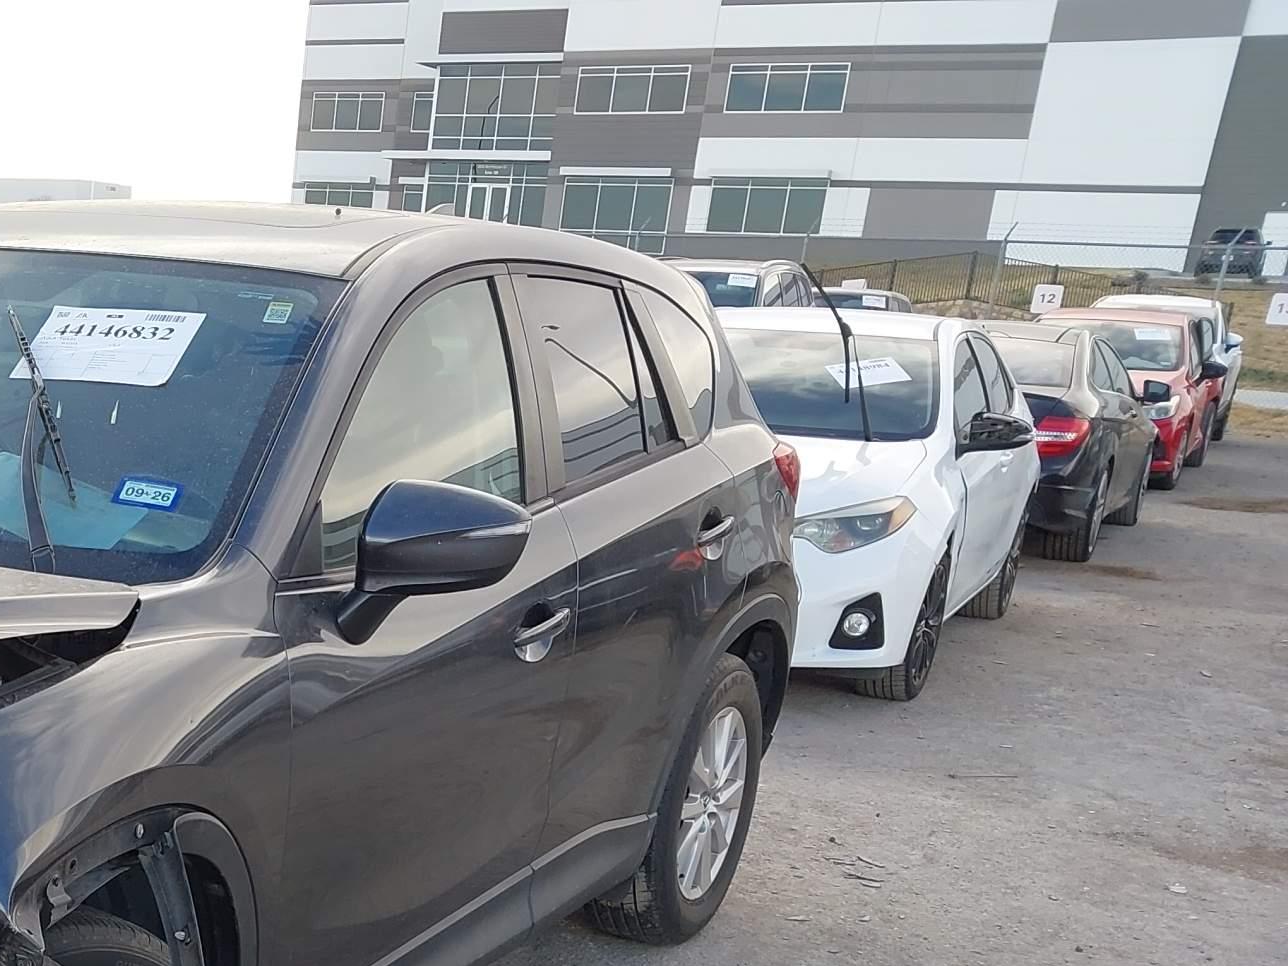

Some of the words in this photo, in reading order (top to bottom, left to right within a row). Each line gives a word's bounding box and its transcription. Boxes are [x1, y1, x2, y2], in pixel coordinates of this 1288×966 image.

[1039, 293, 1056, 304] 12
[1277, 303, 1288, 314] 1
[54, 323, 176, 341] 44146832
